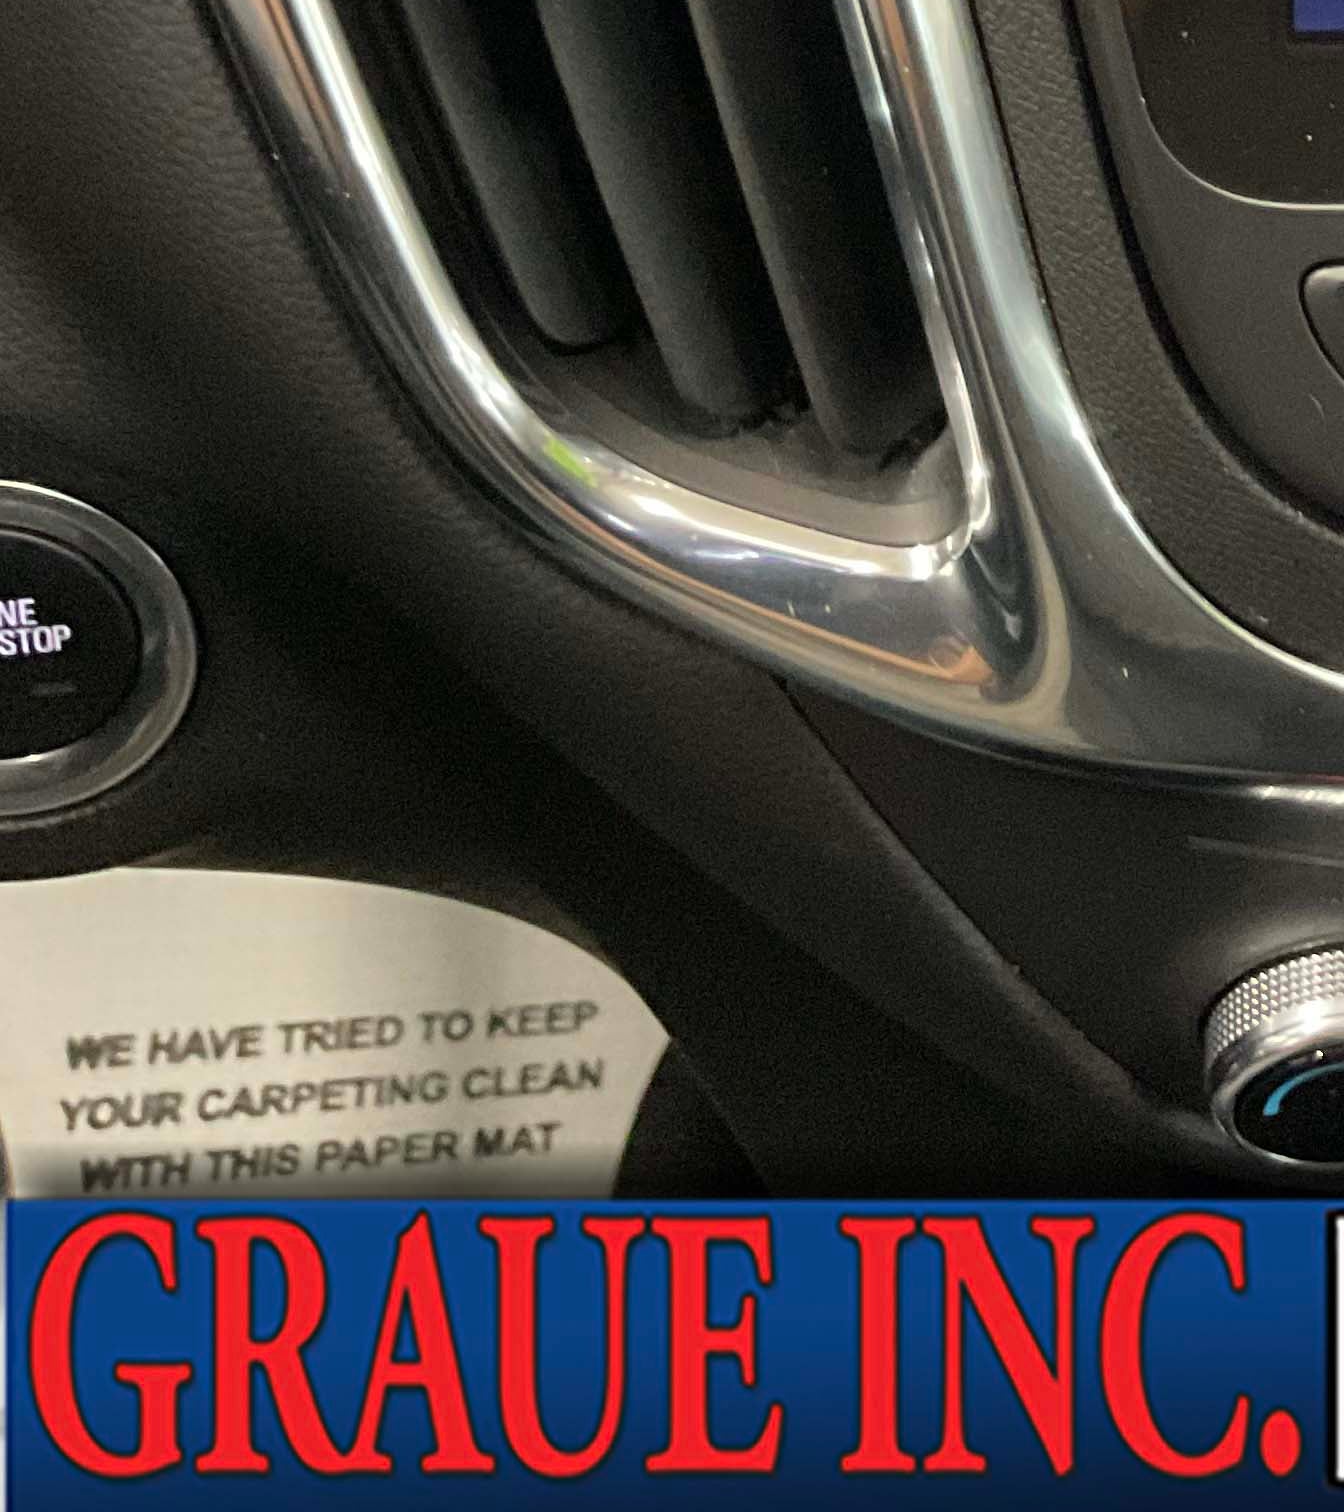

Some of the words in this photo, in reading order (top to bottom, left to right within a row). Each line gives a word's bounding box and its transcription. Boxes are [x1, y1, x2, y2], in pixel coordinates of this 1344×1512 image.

[66, 1032, 134, 1070] WE
[147, 1024, 264, 1065] HAVE
[278, 1014, 405, 1054] TRIED
[418, 1008, 475, 1043] TO
[486, 999, 600, 1038] KEEP
[60, 1092, 182, 1132] YOUR
[196, 1071, 450, 1123] CARPETING
[462, 1057, 605, 1099] CLEAN
[81, 1152, 193, 1193] WITH
[206, 1142, 301, 1184] THIS
[315, 1129, 461, 1172] PAPER
[473, 1121, 564, 1159] MAT
